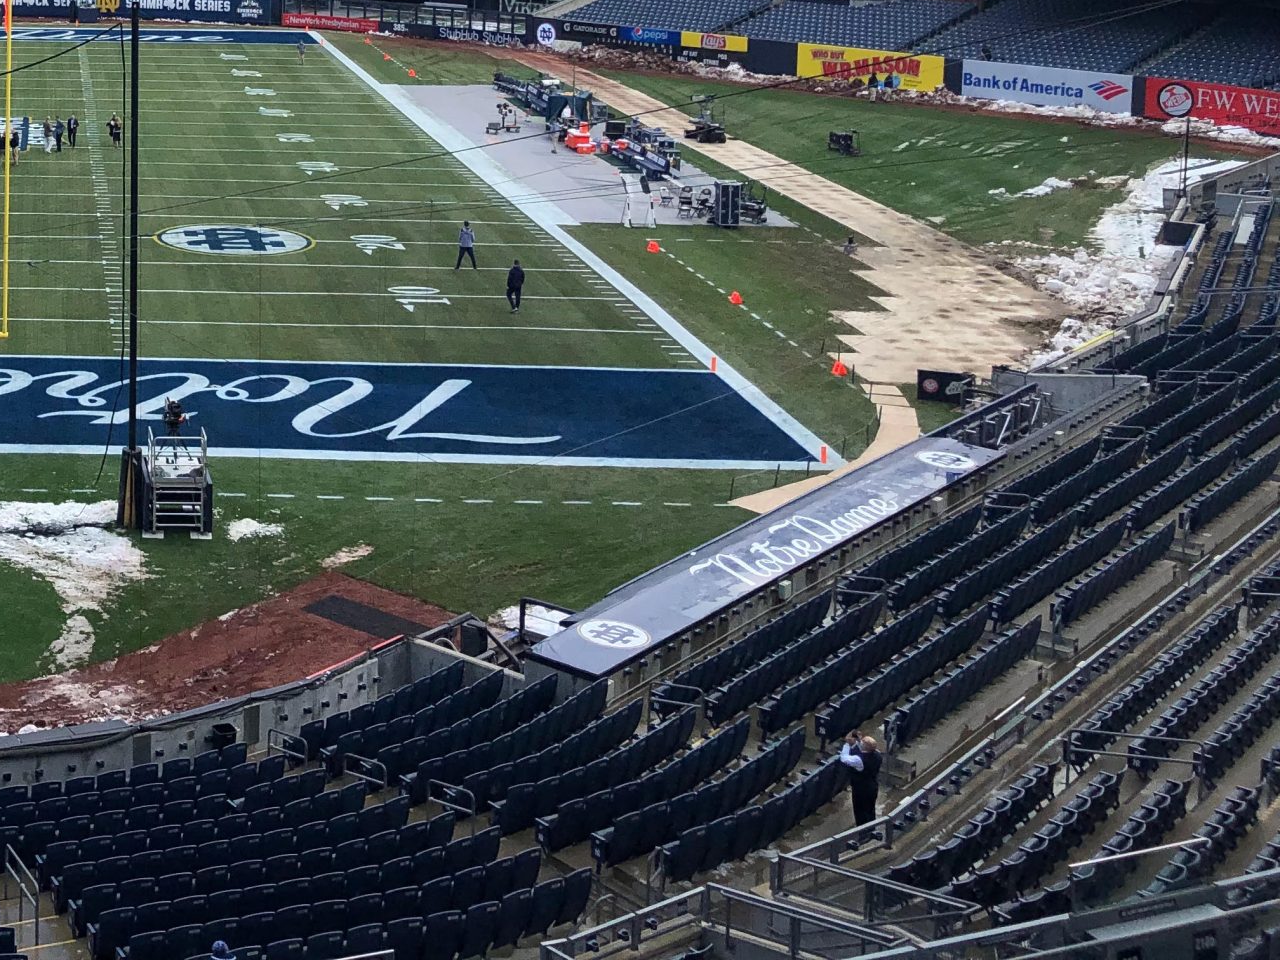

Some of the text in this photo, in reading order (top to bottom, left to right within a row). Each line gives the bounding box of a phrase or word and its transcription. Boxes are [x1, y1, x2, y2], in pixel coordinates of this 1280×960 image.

[194, 0, 231, 12] SERIES
[393, 23, 405, 32] 385
[564, 23, 616, 37] G GATORADE G
[644, 30, 668, 40] pepsi
[439, 27, 520, 44] StubHub StubHub
[963, 72, 1084, 99] Bank of America
[1197, 88, 1236, 112] F.W.
[689, 497, 899, 586] Notre Dame
